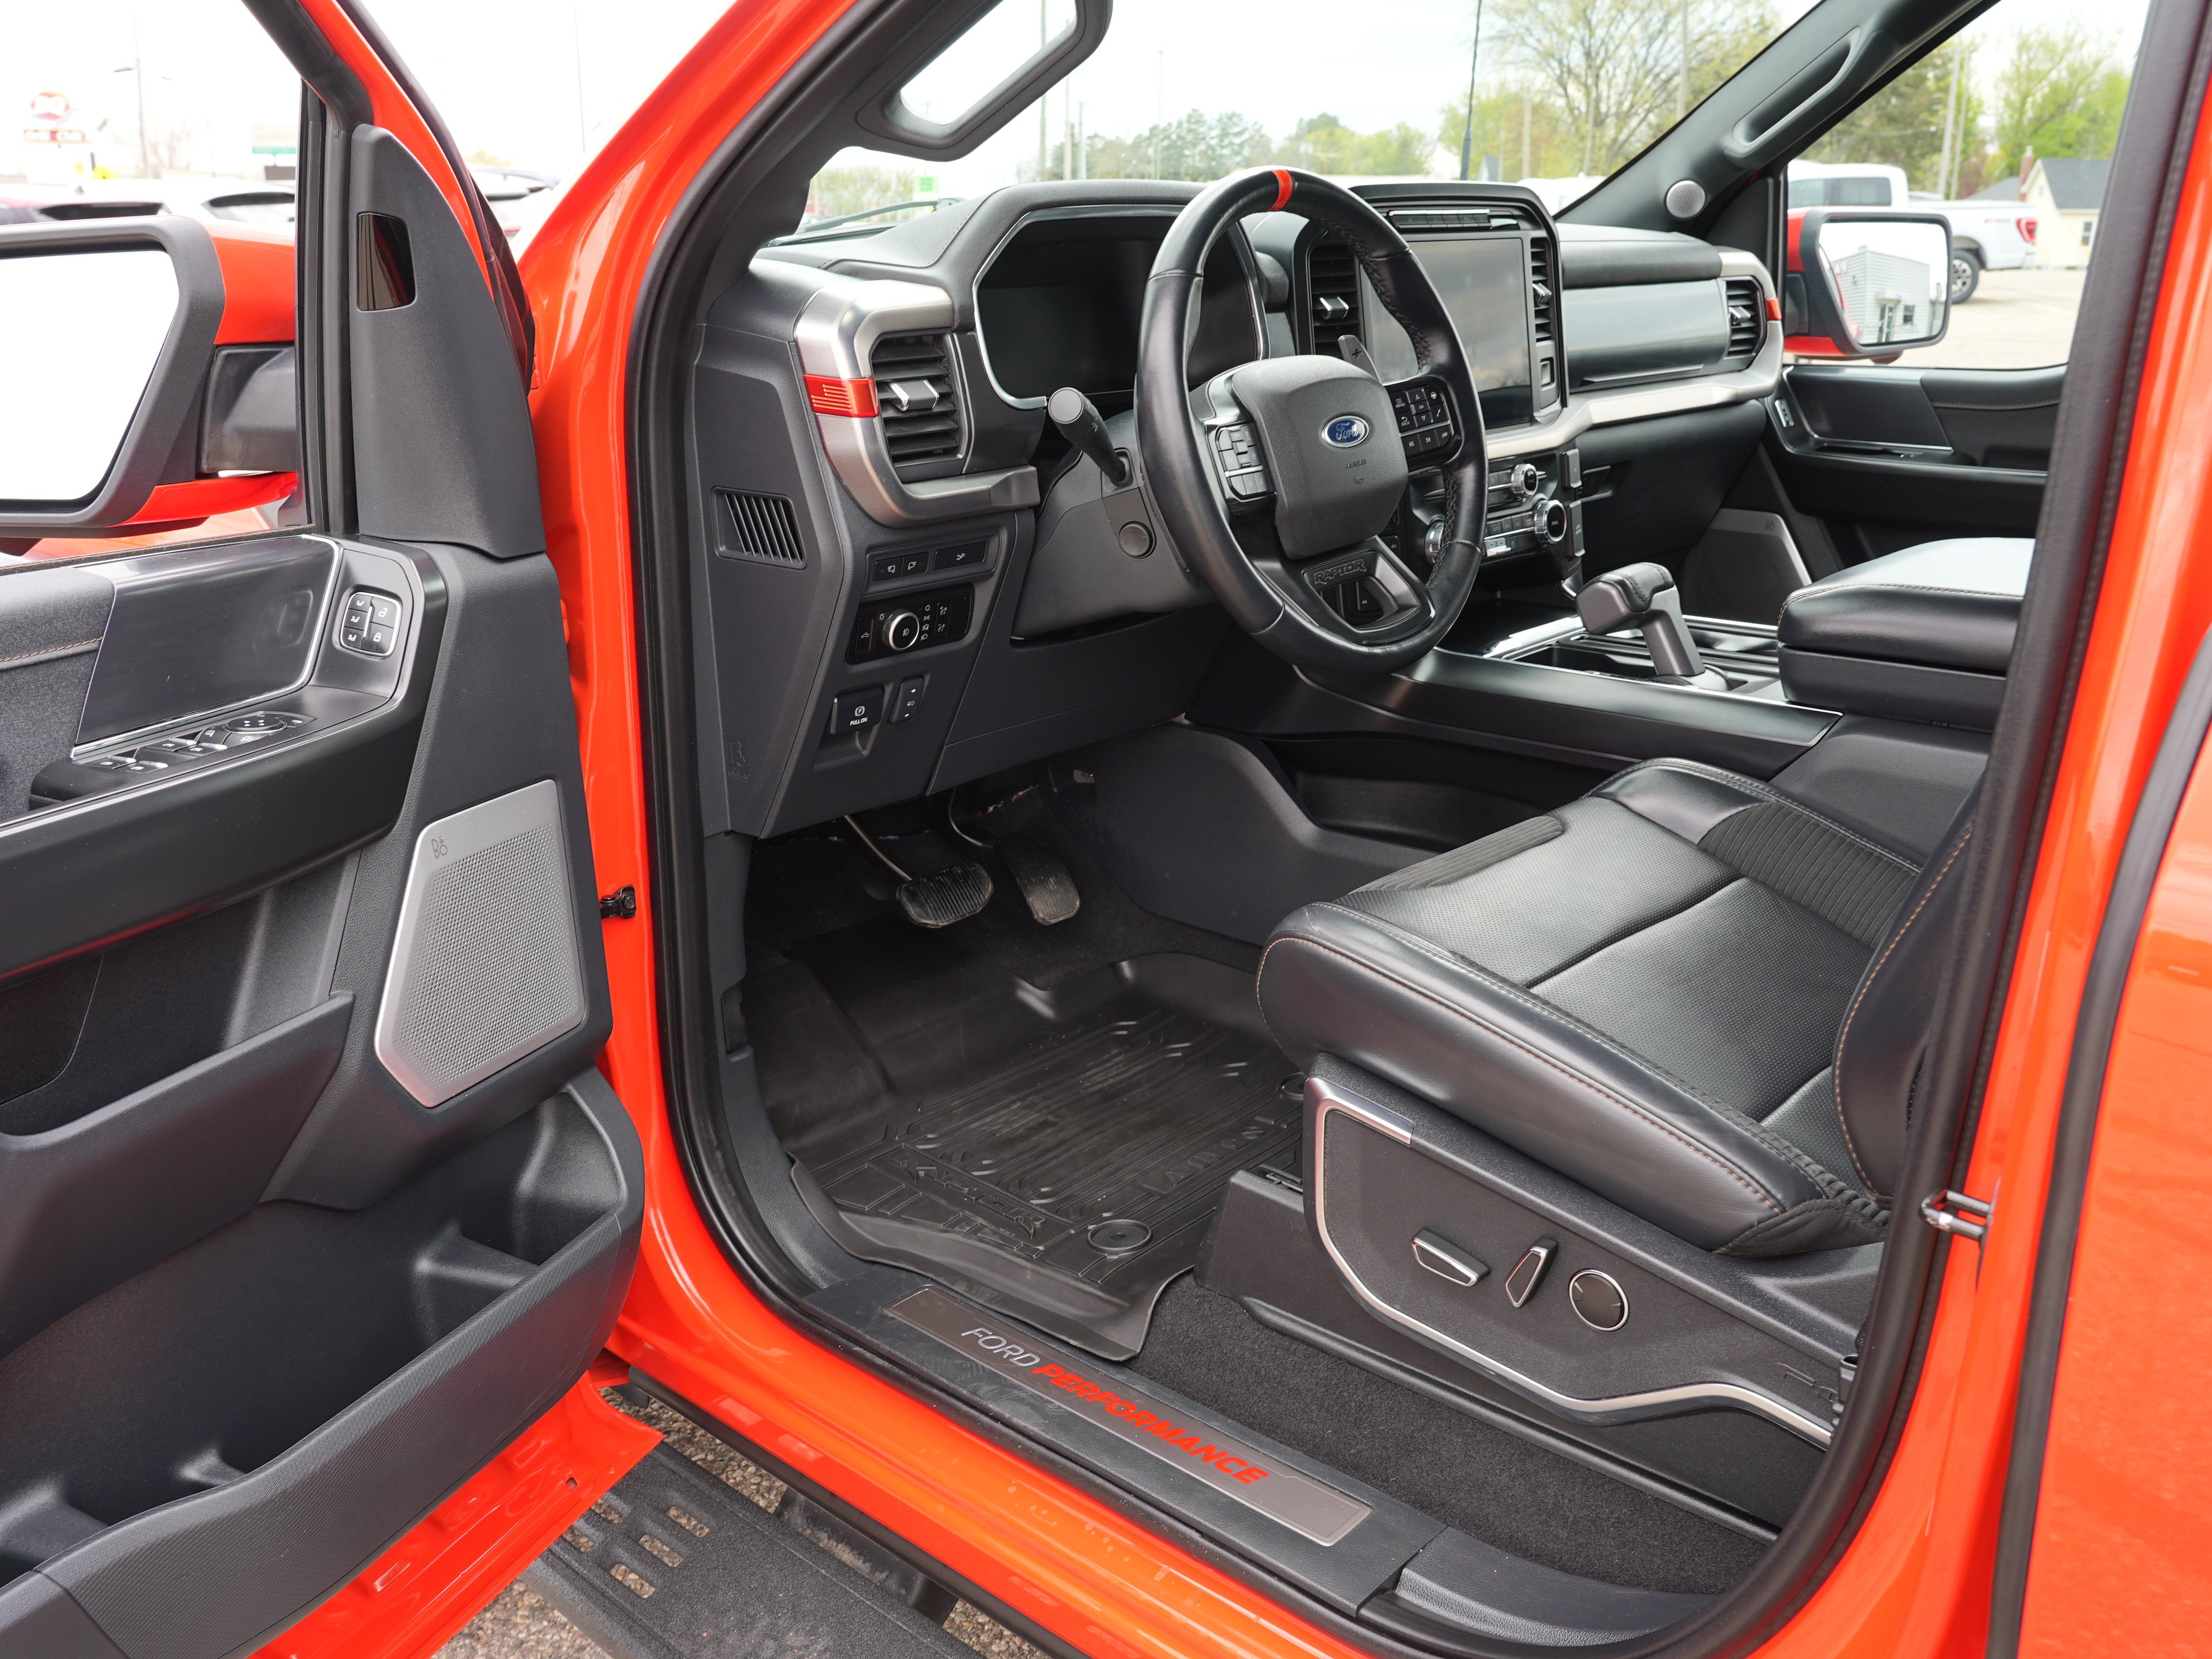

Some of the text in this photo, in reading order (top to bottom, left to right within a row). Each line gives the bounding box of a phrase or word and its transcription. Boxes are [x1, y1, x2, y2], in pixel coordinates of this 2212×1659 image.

[1336, 422, 1359, 441] Ford
[1313, 558, 1367, 584] RAPTOR
[960, 1327, 1270, 1485] FORD PERFORMANCE
